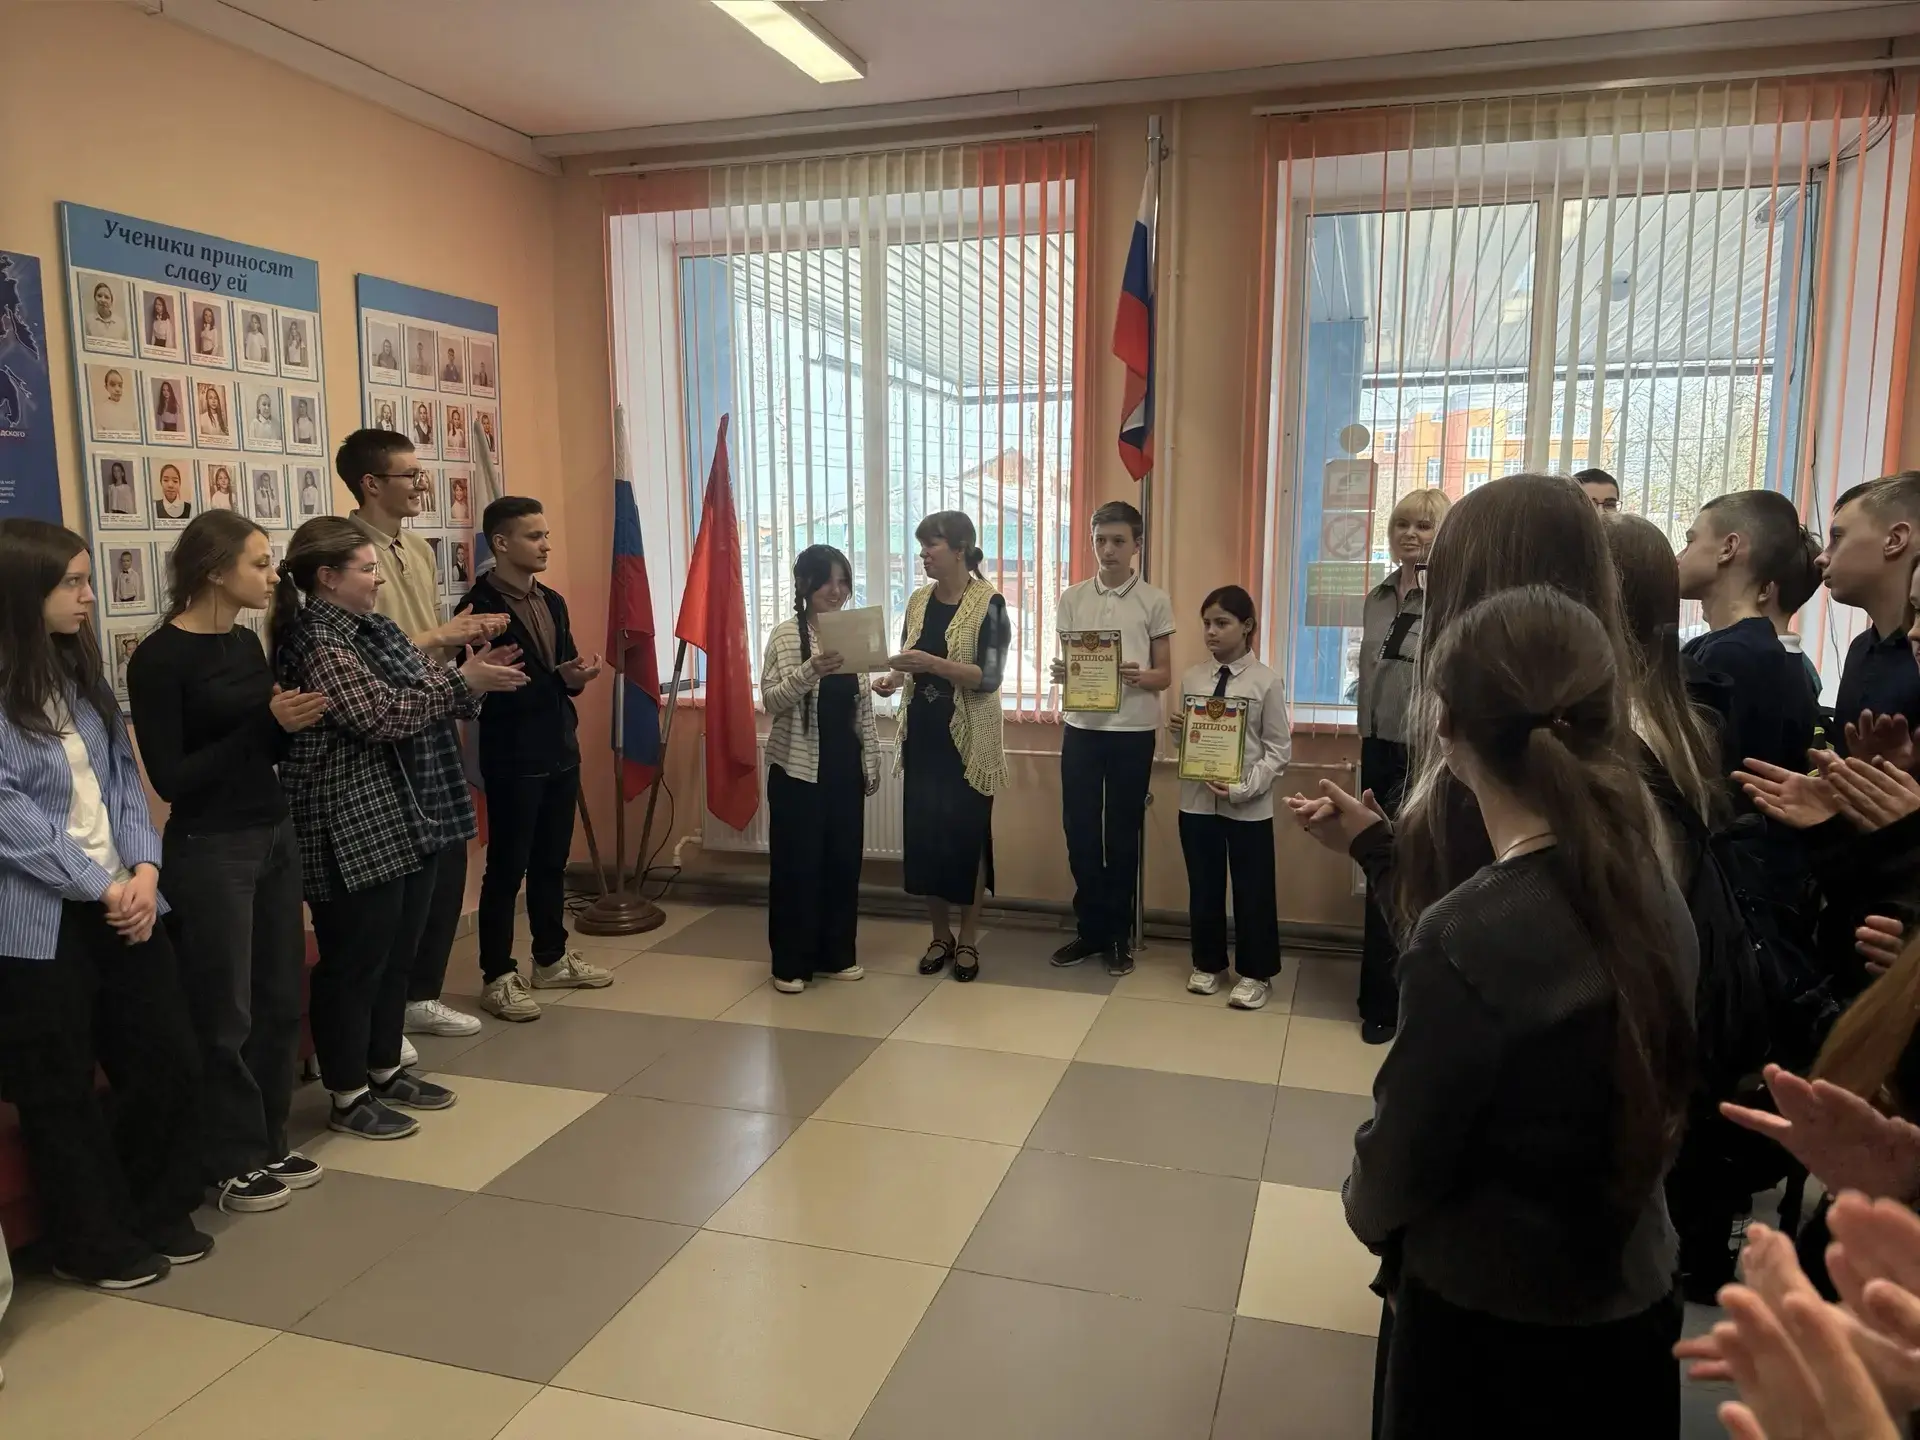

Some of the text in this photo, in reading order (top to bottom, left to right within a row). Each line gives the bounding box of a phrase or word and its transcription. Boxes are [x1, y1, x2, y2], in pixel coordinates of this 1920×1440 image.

[103, 218, 294, 279] Ученики приносят
[164, 262, 248, 293] славу ей
[1070, 654, 1114, 662] ДИПЛОМ
[1191, 722, 1237, 732] ДИПЛОМ
